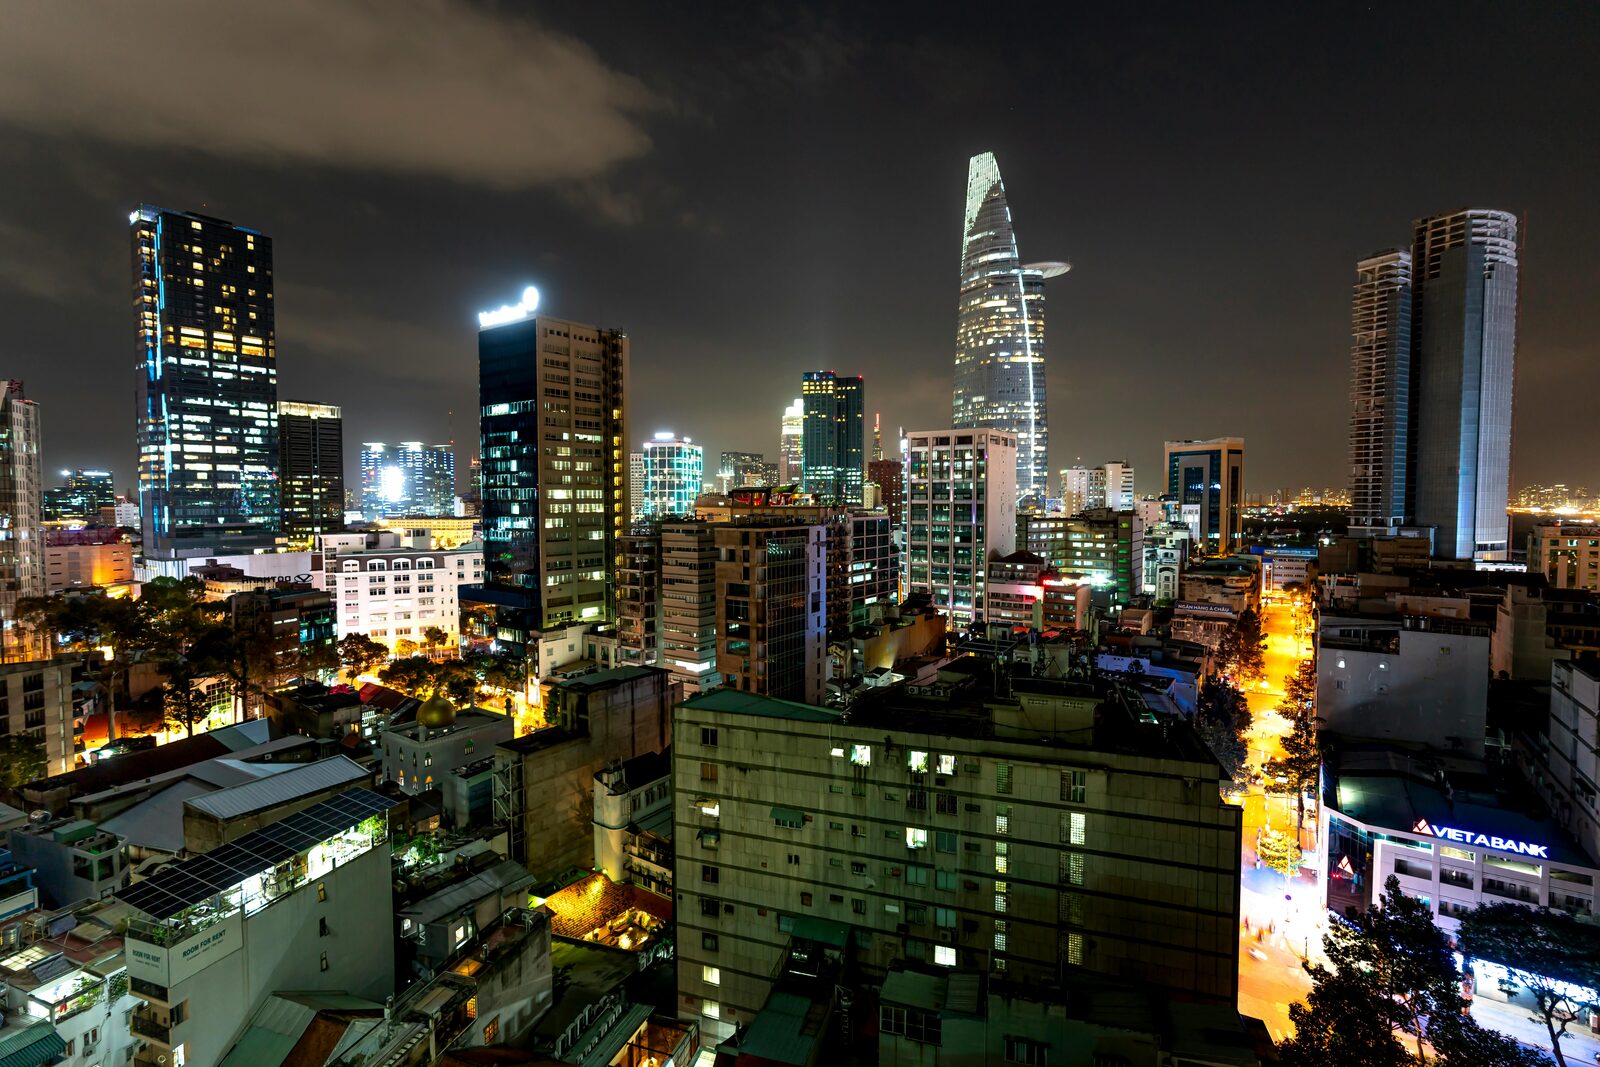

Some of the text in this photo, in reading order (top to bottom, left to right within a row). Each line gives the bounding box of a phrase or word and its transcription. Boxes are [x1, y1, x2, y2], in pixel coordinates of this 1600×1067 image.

[1431, 824, 1548, 858] VIETABANK
[132, 949, 143, 958] ROOM
[143, 952, 151, 961] FOR
[151, 954, 161, 964] RENT
[182, 943, 200, 958] ROOM
[200, 937, 212, 949] FOR
[212, 928, 226, 942] RENT
